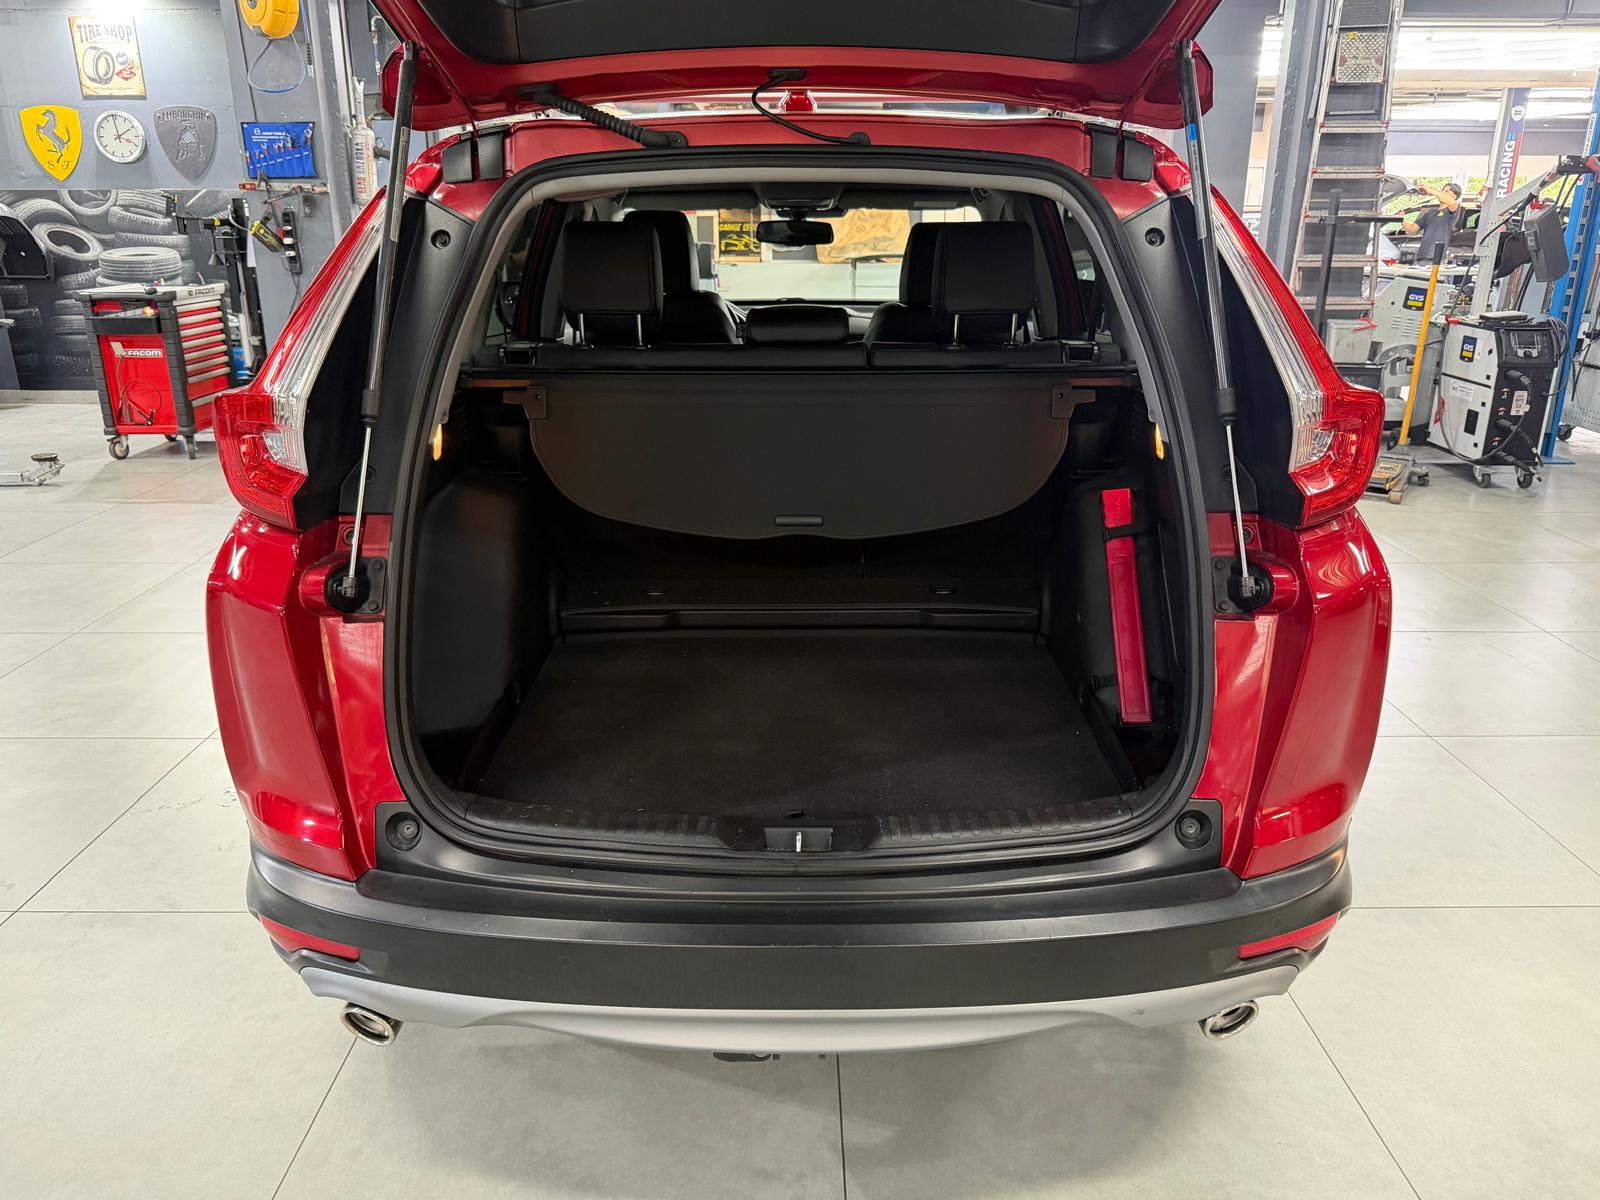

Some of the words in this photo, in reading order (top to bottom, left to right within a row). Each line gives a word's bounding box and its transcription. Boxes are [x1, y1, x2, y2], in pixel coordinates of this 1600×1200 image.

[77, 24, 102, 43] TIRE
[104, 24, 132, 43] SHOP
[1496, 140, 1516, 199] RACING
[1408, 293, 1425, 302] GYS
[1463, 343, 1474, 352] GYS
[127, 349, 162, 357] FACOM
